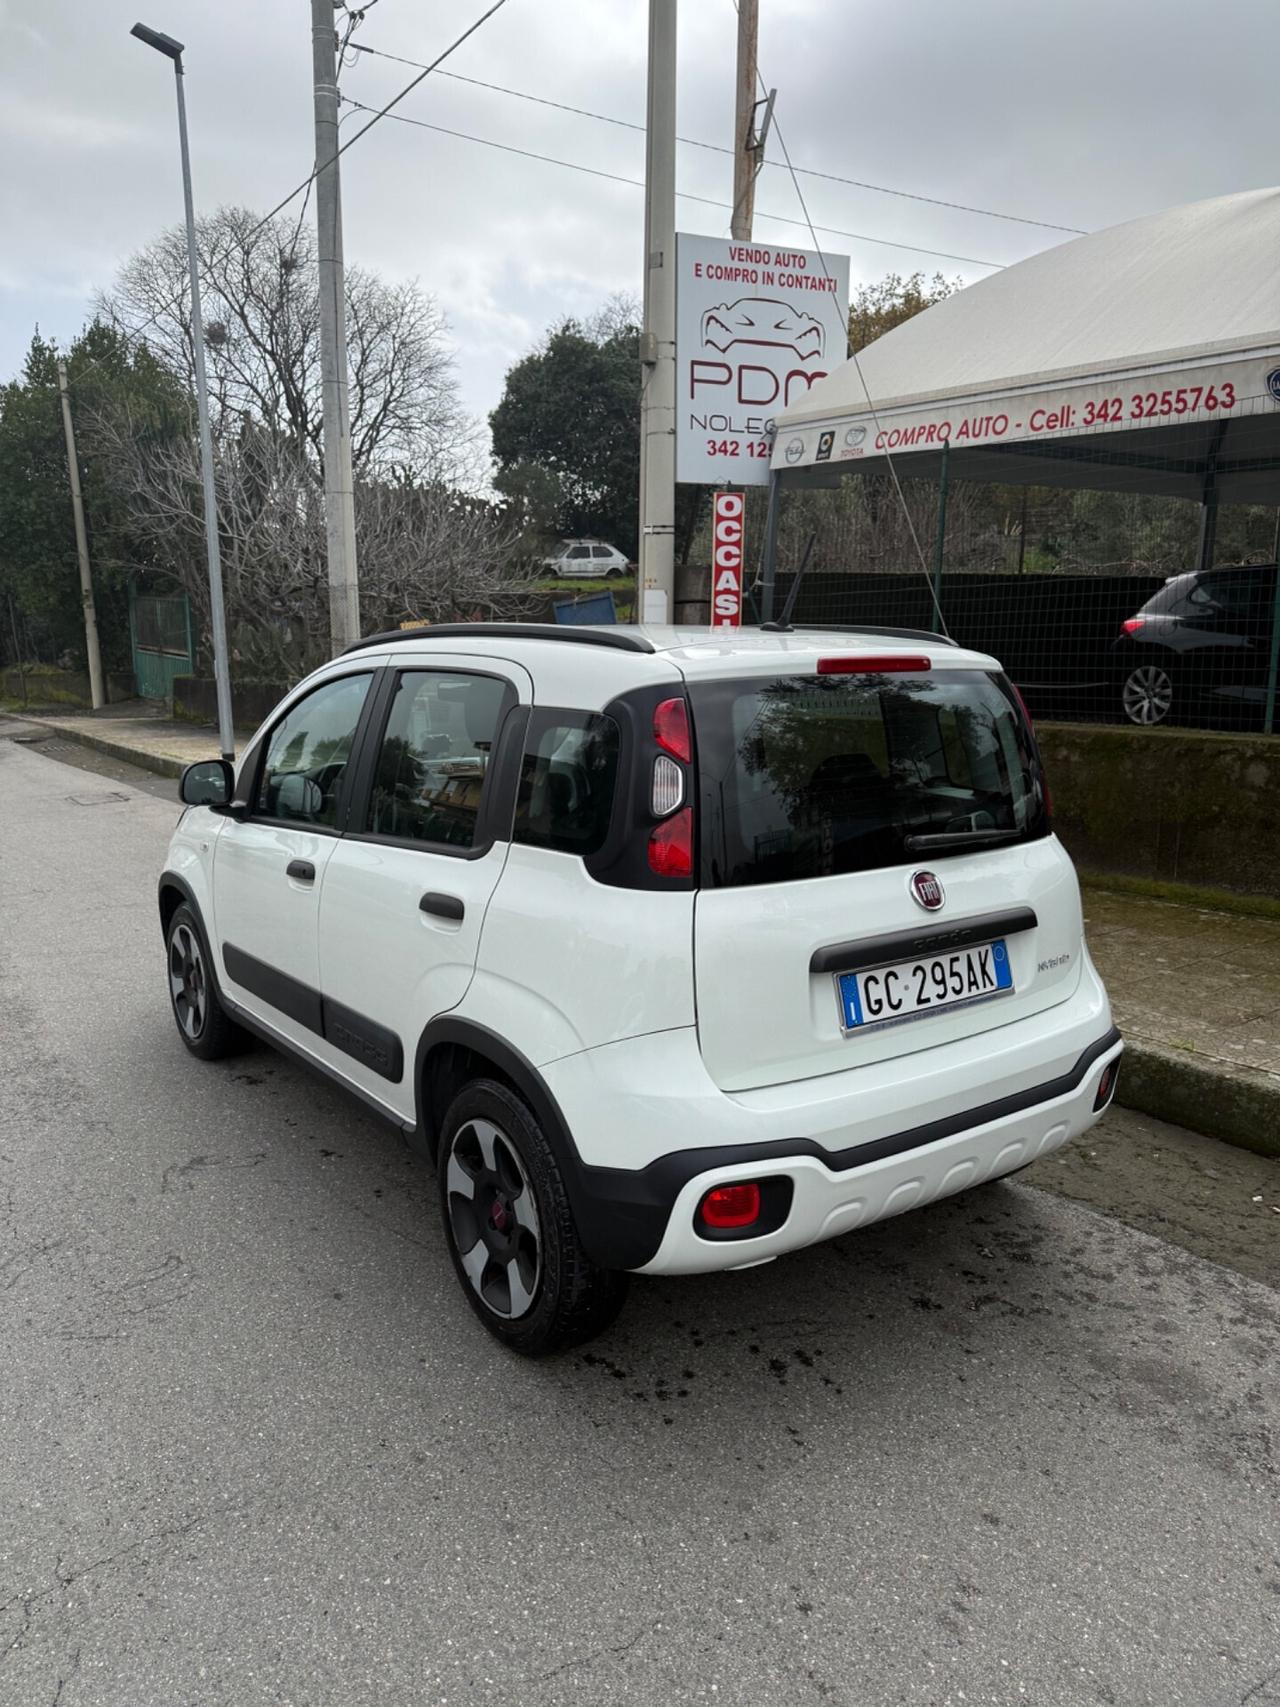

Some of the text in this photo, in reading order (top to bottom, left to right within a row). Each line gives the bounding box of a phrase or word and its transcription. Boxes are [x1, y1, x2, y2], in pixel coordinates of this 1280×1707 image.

[729, 246, 807, 269] VENDO AUTO
[694, 263, 838, 293] E COMPRO IN CONTANTI
[874, 421, 952, 451] COMPRO
[956, 413, 1009, 441] AUTO
[1029, 406, 1077, 434] Cell:
[1082, 397, 1124, 428] 342
[1131, 382, 1236, 420] 3255763
[706, 440, 740, 457] 342
[918, 880, 940, 900] FIAT
[863, 970, 903, 1016] GC
[912, 948, 995, 1005] 295AK
